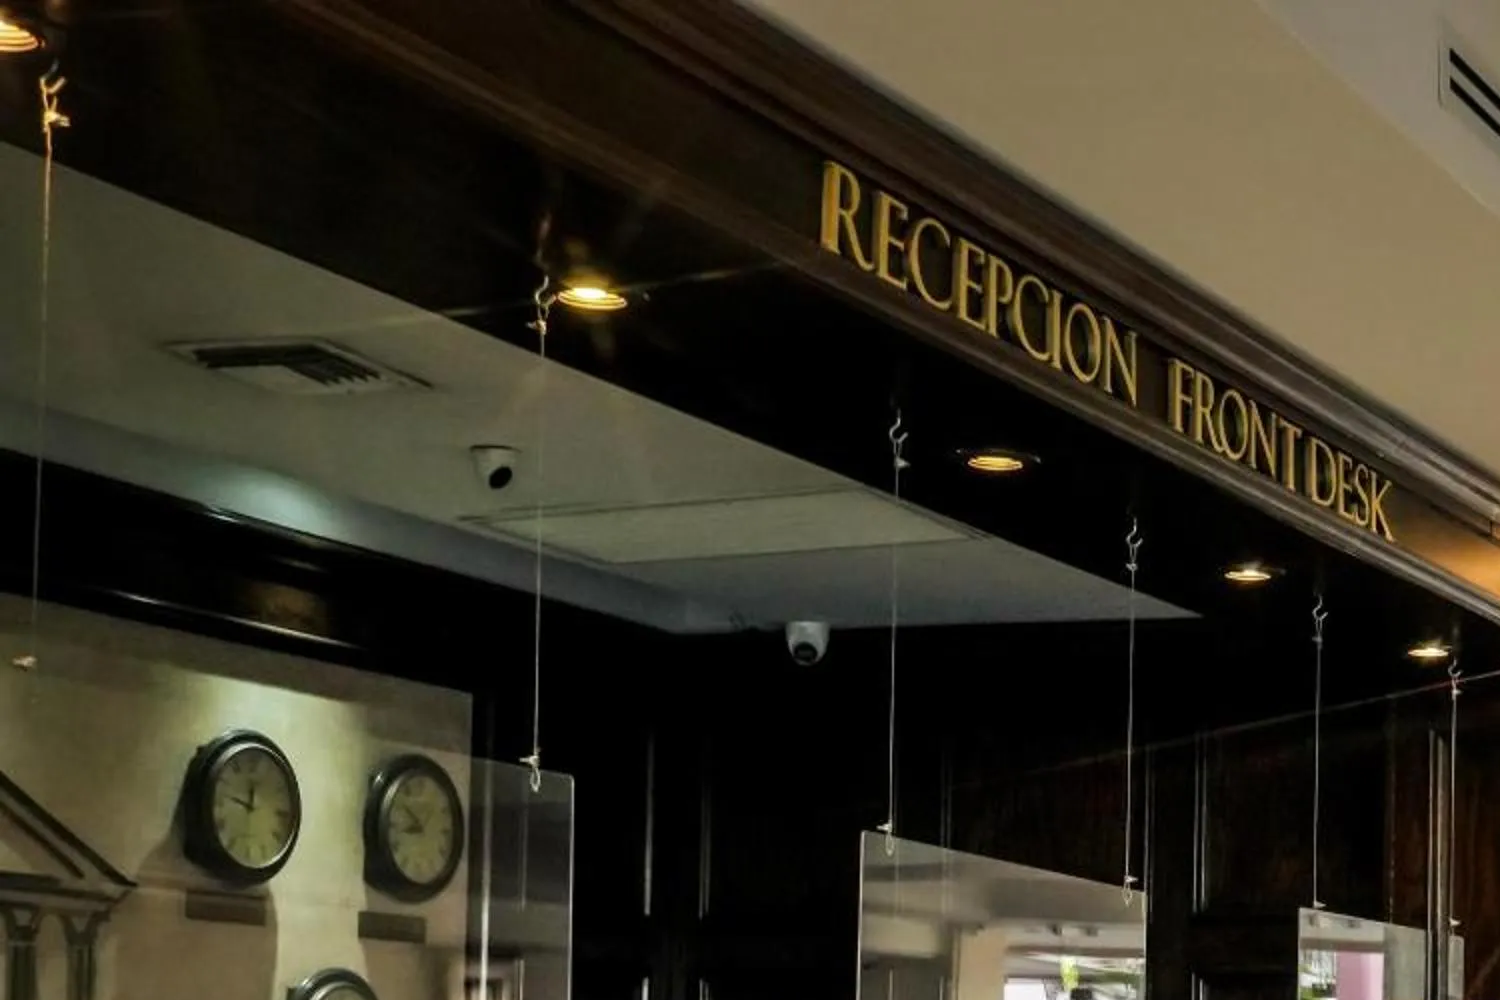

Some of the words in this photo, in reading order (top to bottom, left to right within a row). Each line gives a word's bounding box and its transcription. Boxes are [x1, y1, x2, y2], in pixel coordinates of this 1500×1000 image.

[820, 160, 1139, 406] RECEPCION
[1168, 357, 1303, 493] FRONT
[1304, 430, 1396, 543] DESK
